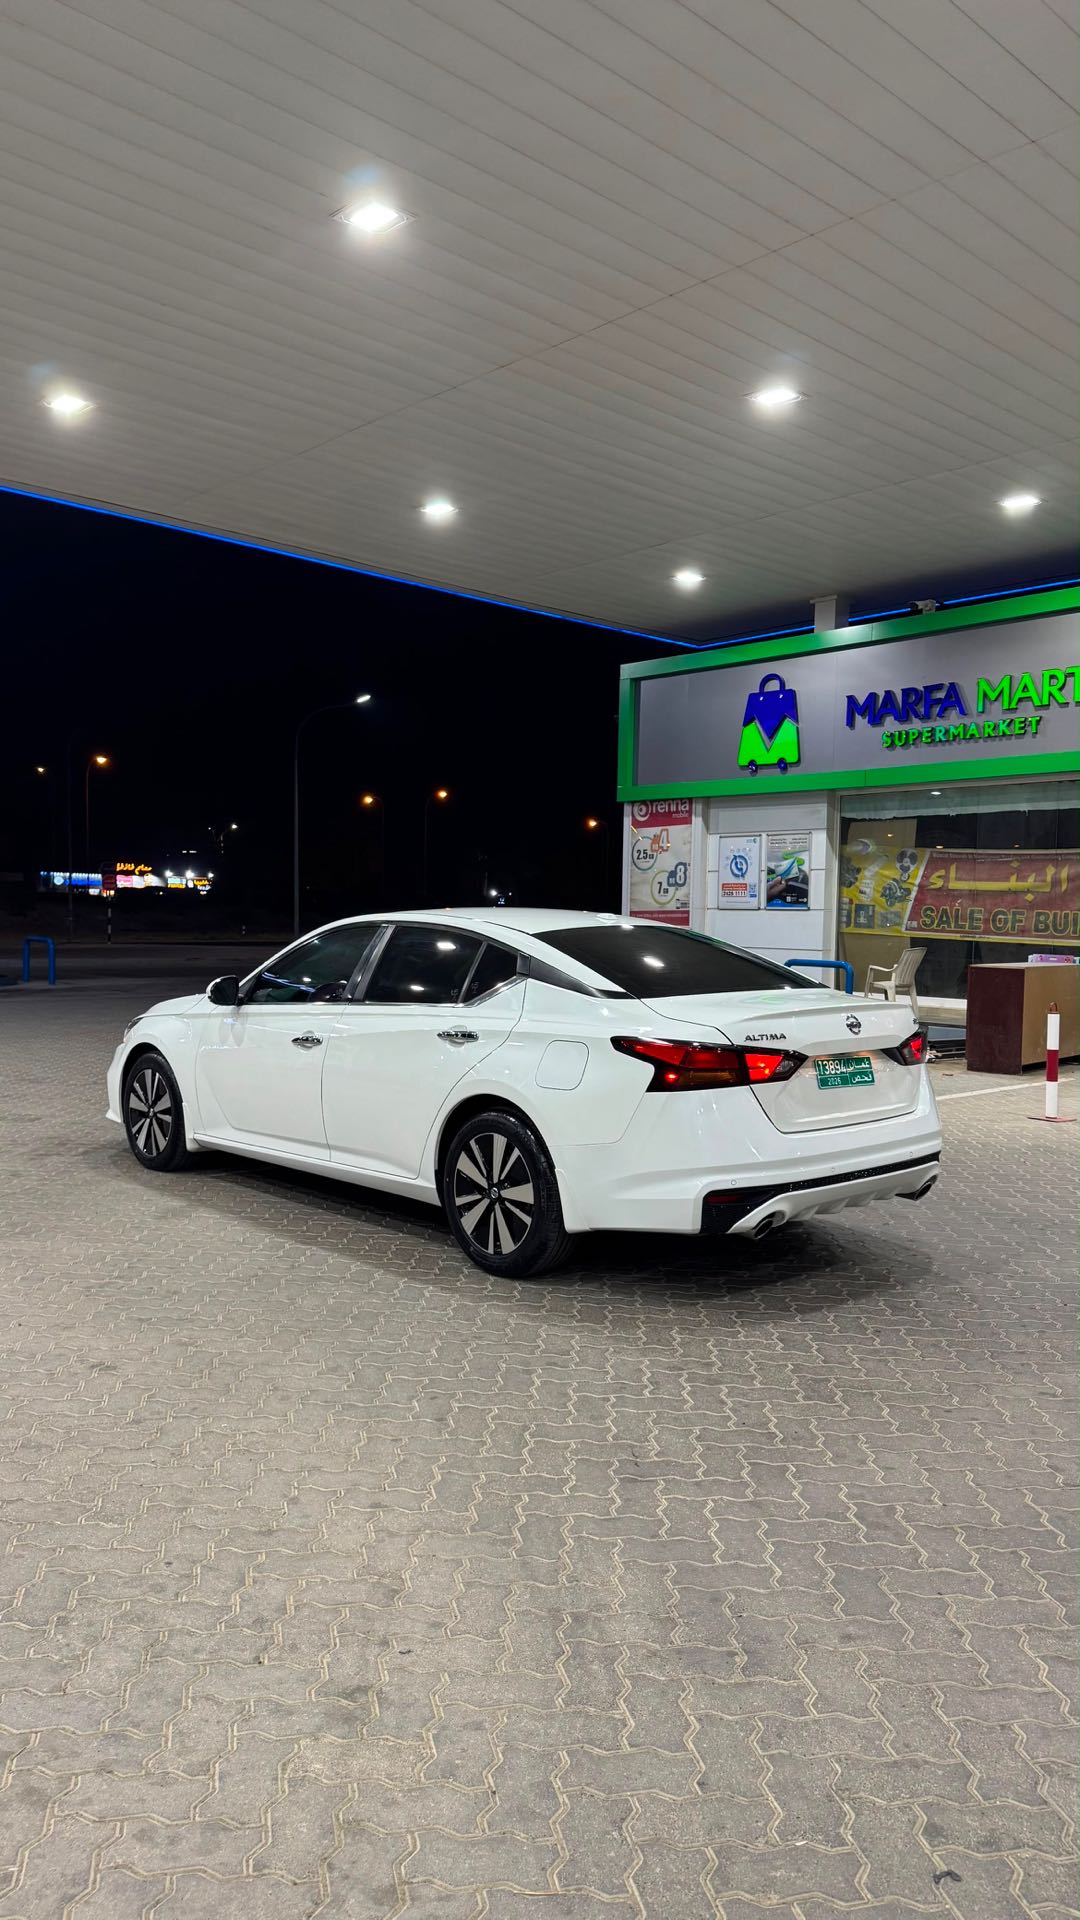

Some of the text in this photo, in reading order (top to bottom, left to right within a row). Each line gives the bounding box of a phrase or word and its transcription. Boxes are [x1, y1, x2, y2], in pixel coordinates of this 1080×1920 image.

[845, 666, 1080, 728] MARFA MART
[881, 715, 1042, 749] SUPERMARKET
[652, 799, 689, 813] renna
[636, 849, 648, 860] 2.5
[926, 860, 1069, 902] البناء
[920, 905, 984, 932] SALE
[990, 908, 1026, 933] OF
[744, 1033, 787, 1042] ALTIMA
[818, 1060, 847, 1075] 13894
